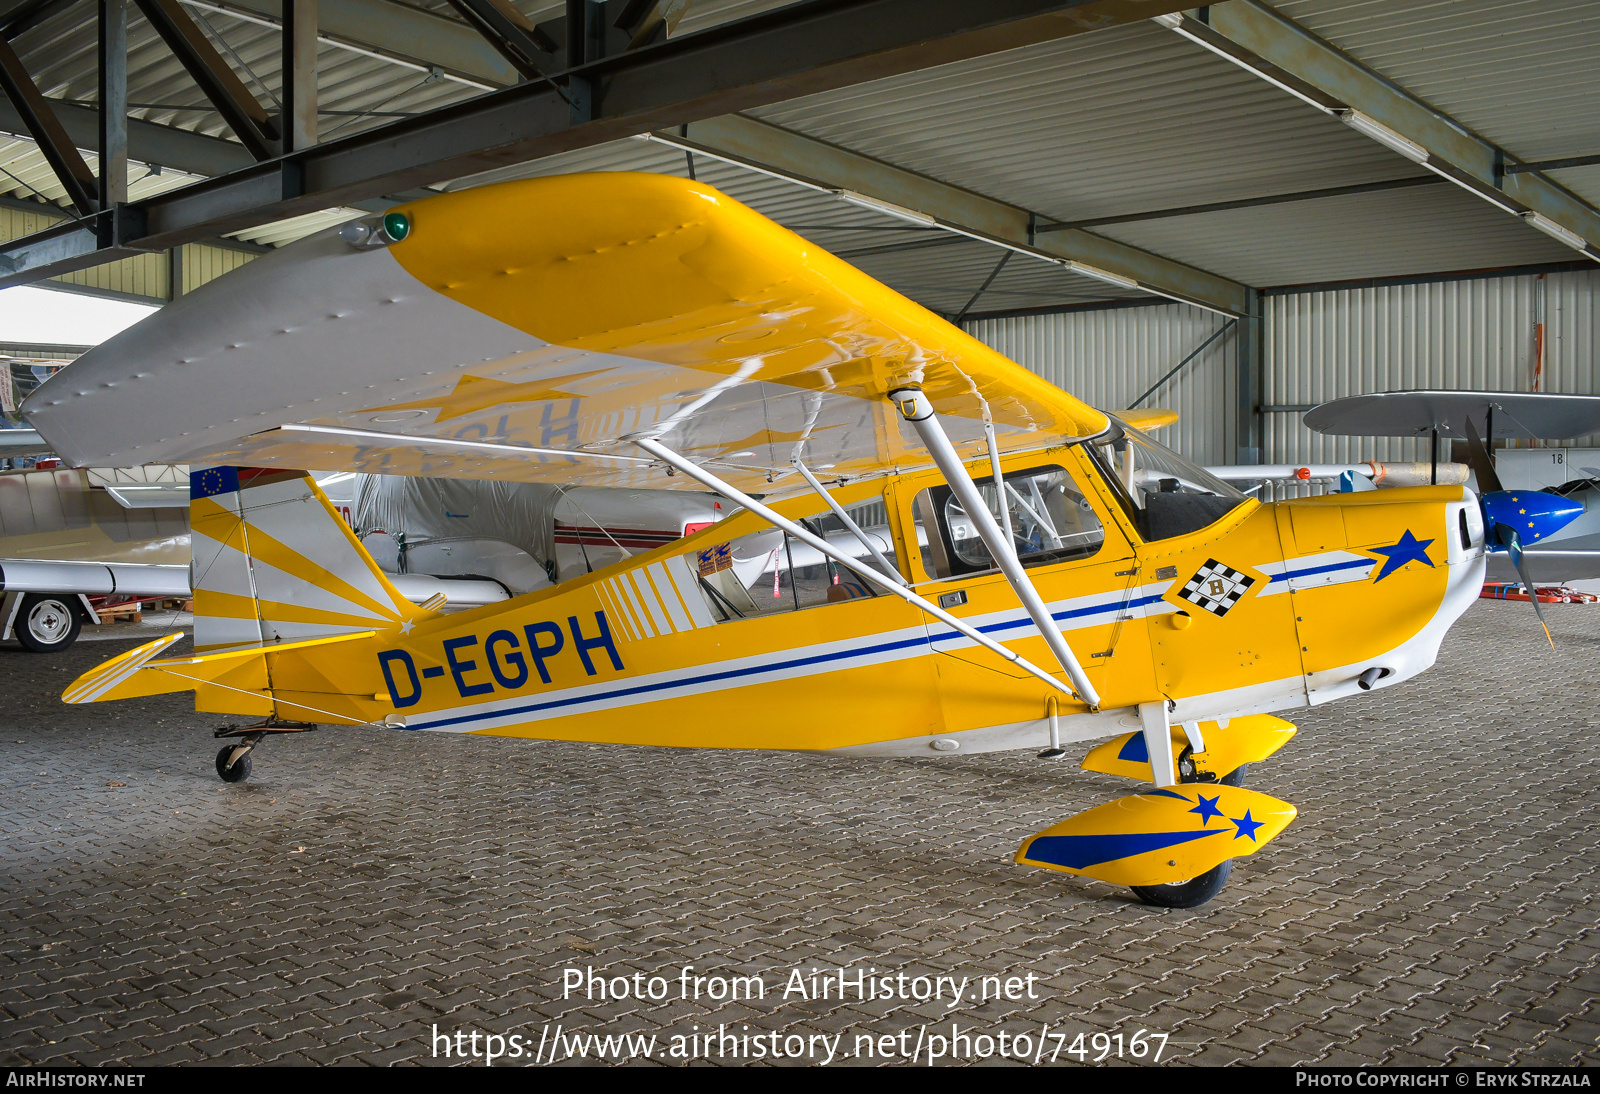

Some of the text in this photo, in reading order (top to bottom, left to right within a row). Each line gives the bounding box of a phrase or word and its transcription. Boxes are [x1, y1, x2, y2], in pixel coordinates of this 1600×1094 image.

[1551, 453, 1564, 465] 18
[1207, 578, 1225, 597] B
[377, 610, 625, 709] D-EGPH
